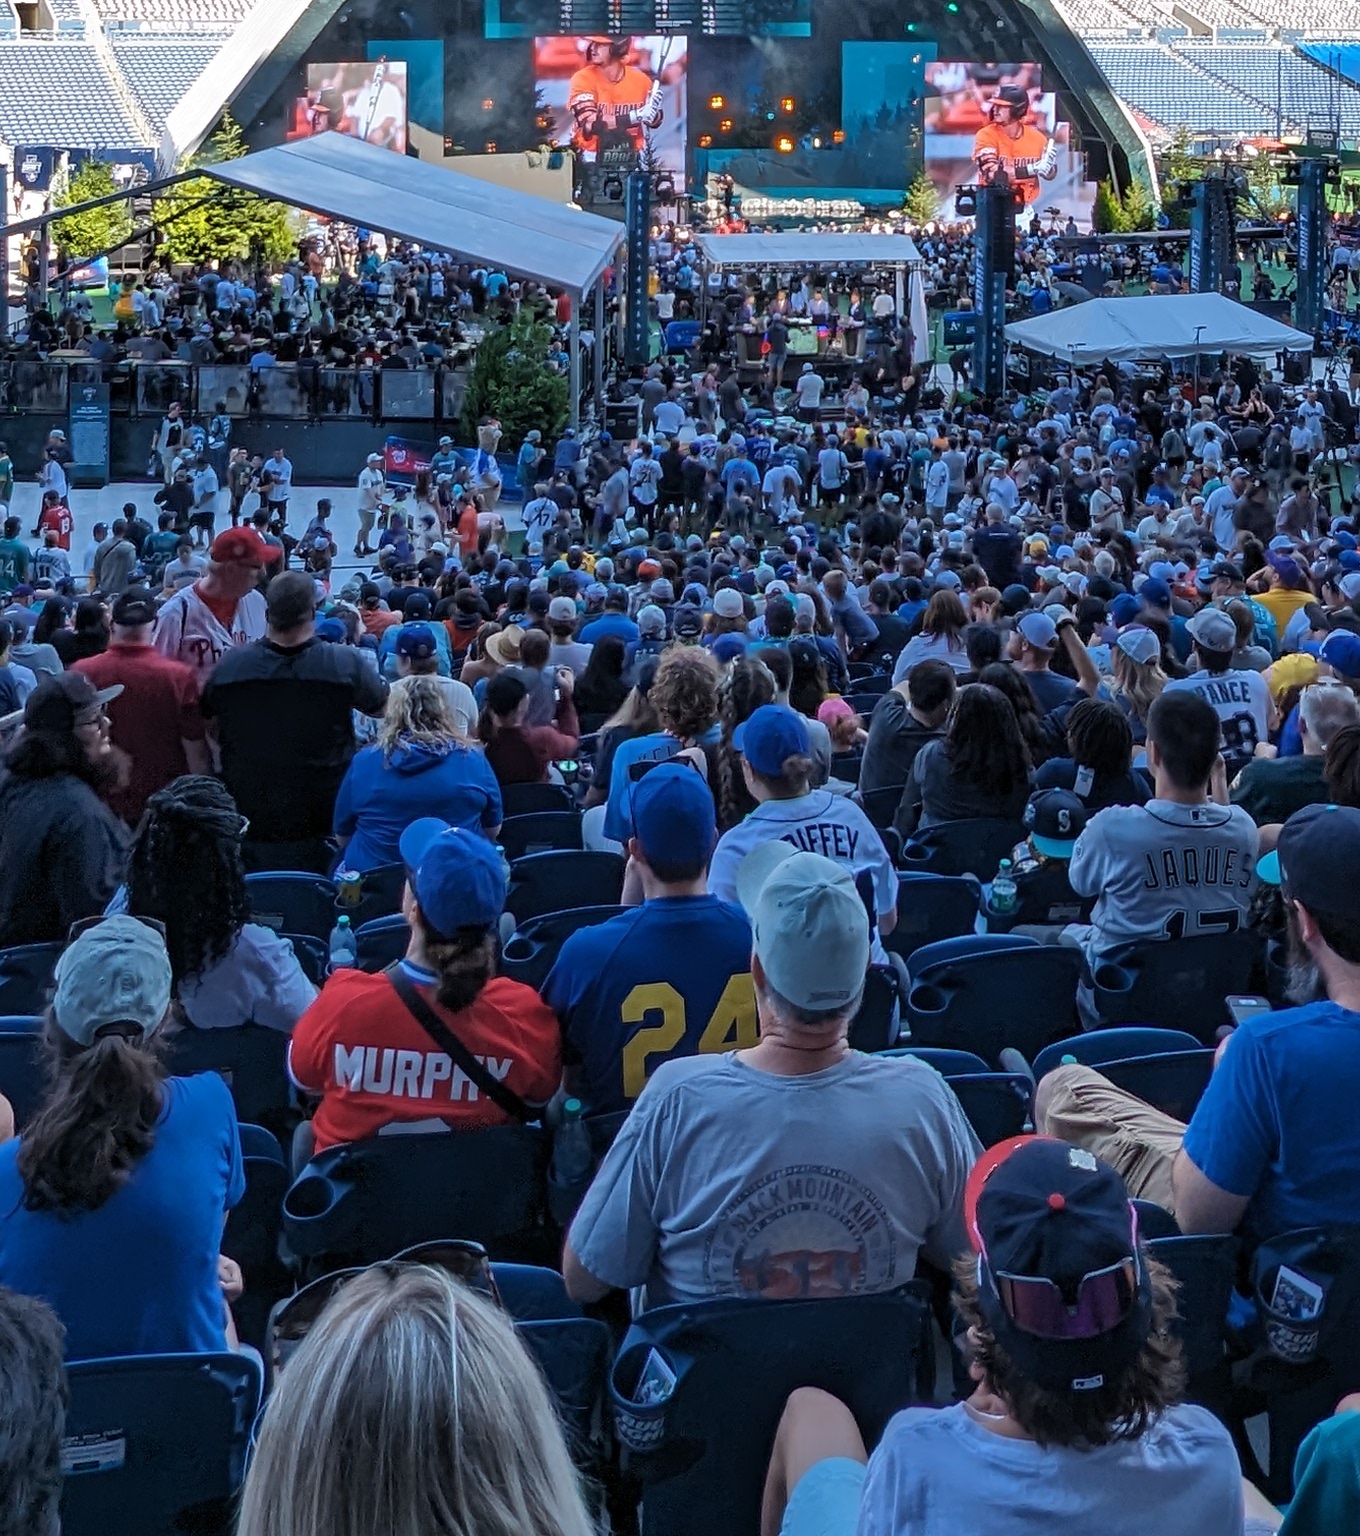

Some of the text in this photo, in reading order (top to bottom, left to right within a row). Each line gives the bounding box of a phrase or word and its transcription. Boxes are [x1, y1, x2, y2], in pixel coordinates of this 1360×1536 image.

[1142, 846, 1252, 890] JAQUES
[620, 971, 761, 1099] 24
[731, 1176, 879, 1234] BLACK MOUNTAIN
